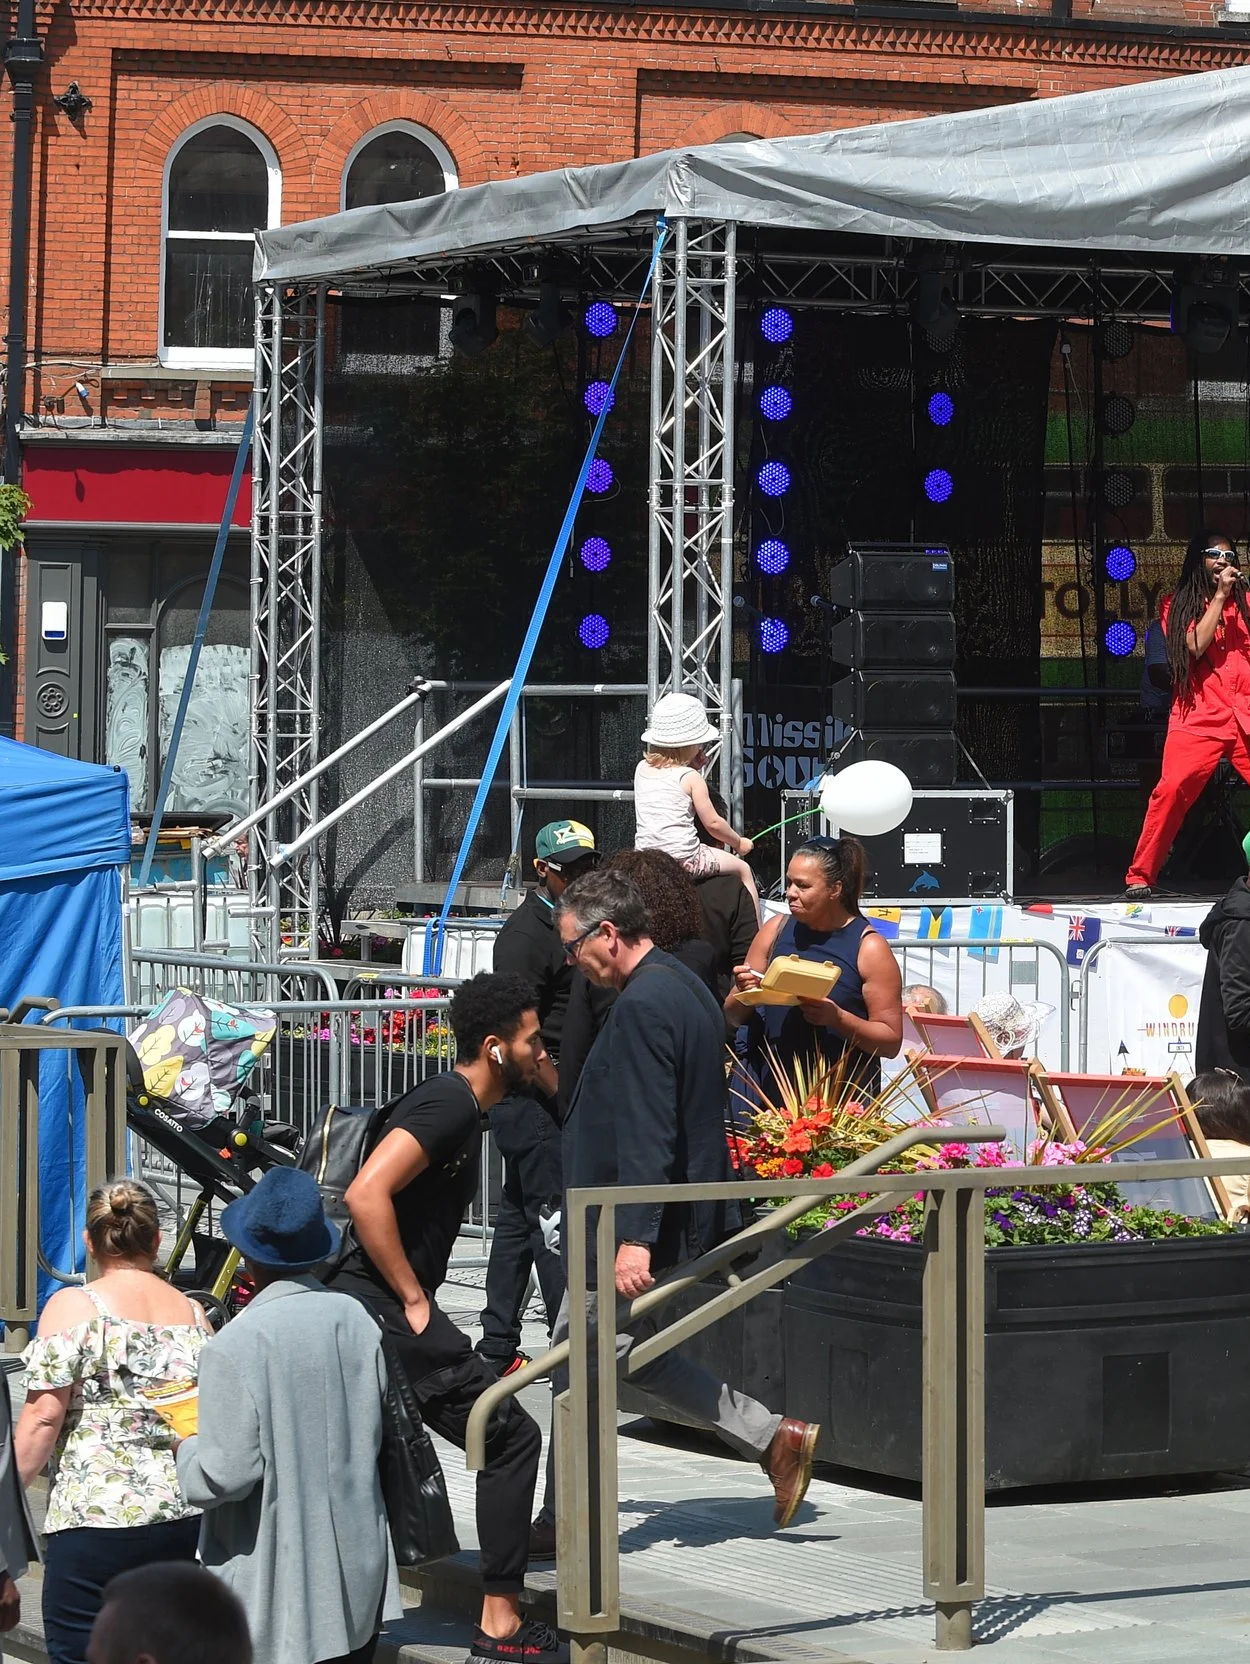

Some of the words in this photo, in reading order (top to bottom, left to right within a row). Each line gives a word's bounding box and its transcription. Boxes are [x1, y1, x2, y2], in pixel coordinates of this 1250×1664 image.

[743, 712, 853, 749] Missil
[1145, 1022, 1195, 1038] WINDRU
[154, 1108, 183, 1132] COSATTO
